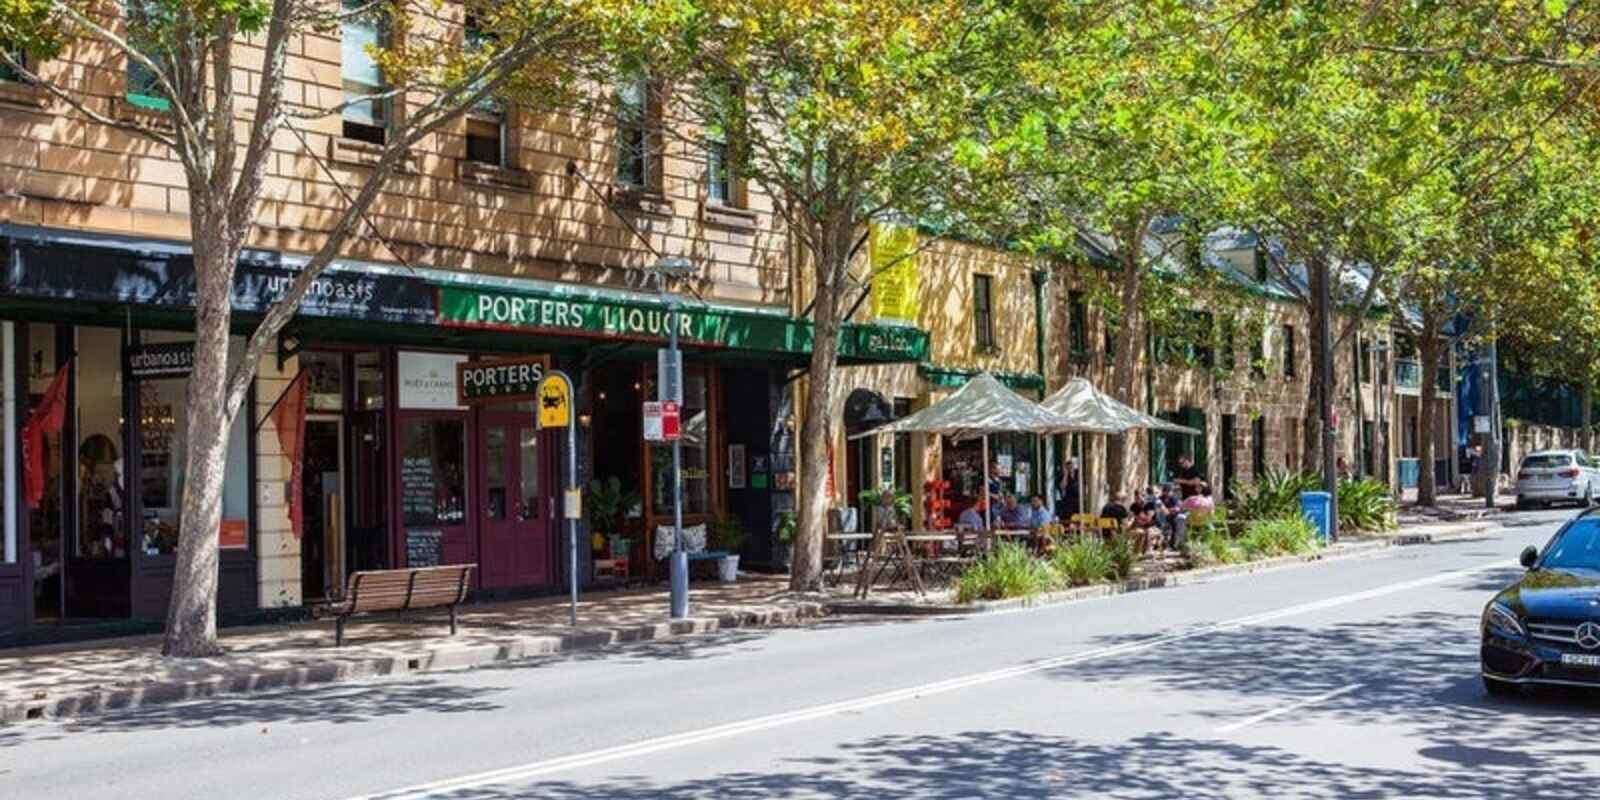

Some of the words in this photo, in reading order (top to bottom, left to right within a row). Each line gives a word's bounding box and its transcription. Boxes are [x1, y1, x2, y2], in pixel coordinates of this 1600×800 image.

[268, 272, 376, 300] urbnoasis
[479, 295, 584, 328] PORTERS
[129, 347, 193, 368] urbanoasi
[464, 363, 544, 387] PORTERS
